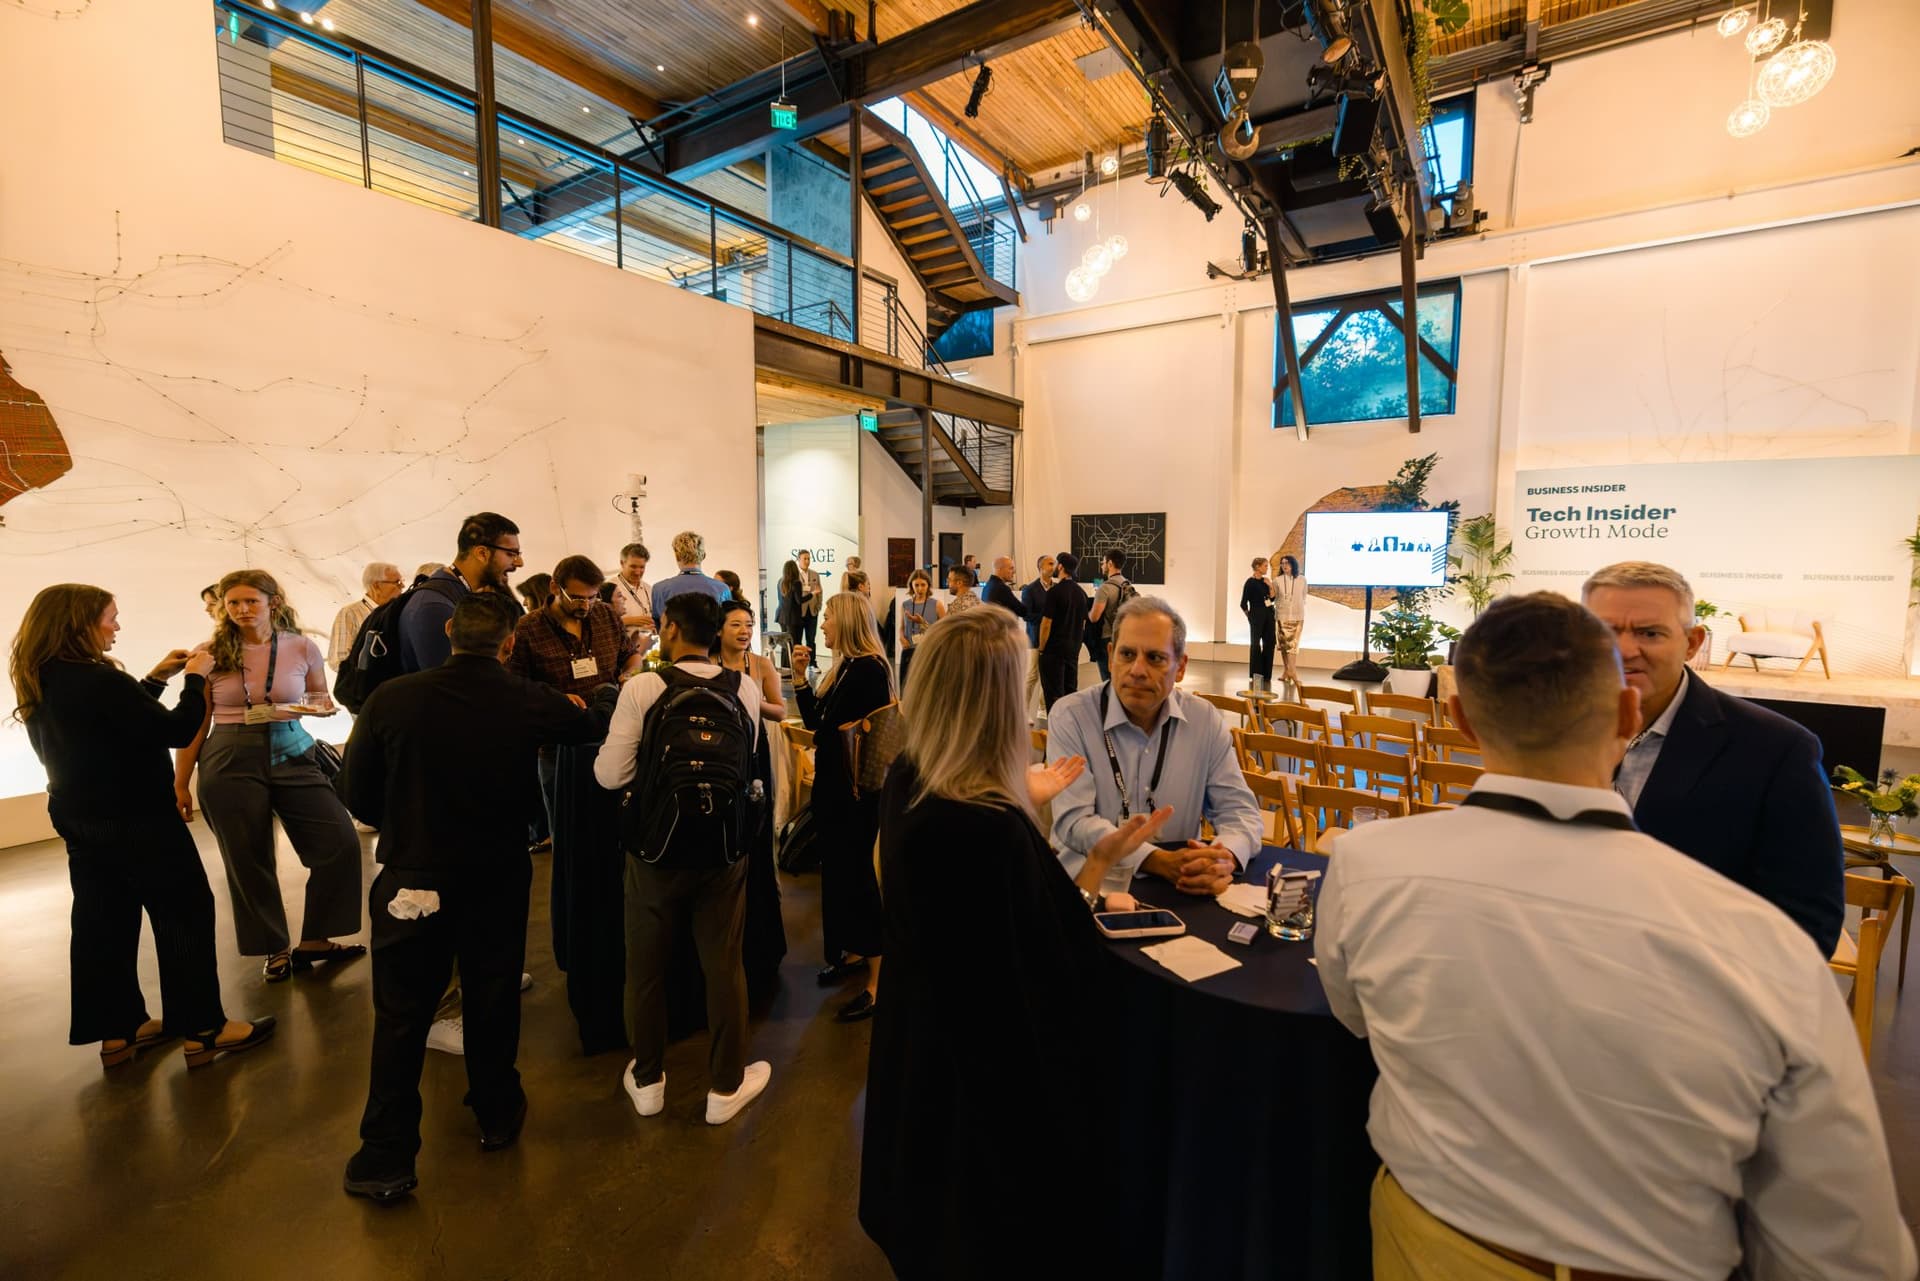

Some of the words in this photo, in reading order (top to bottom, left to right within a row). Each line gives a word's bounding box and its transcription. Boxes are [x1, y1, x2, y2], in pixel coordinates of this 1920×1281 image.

[1527, 486, 1579, 496] BUSINESS
[1581, 484, 1626, 493] INSIDER
[1527, 506, 1581, 522] Tech
[1586, 504, 1676, 521] Insider
[1525, 524, 1600, 540] Growth
[1607, 523, 1669, 539] Mode
[791, 549, 835, 562] SAGE
